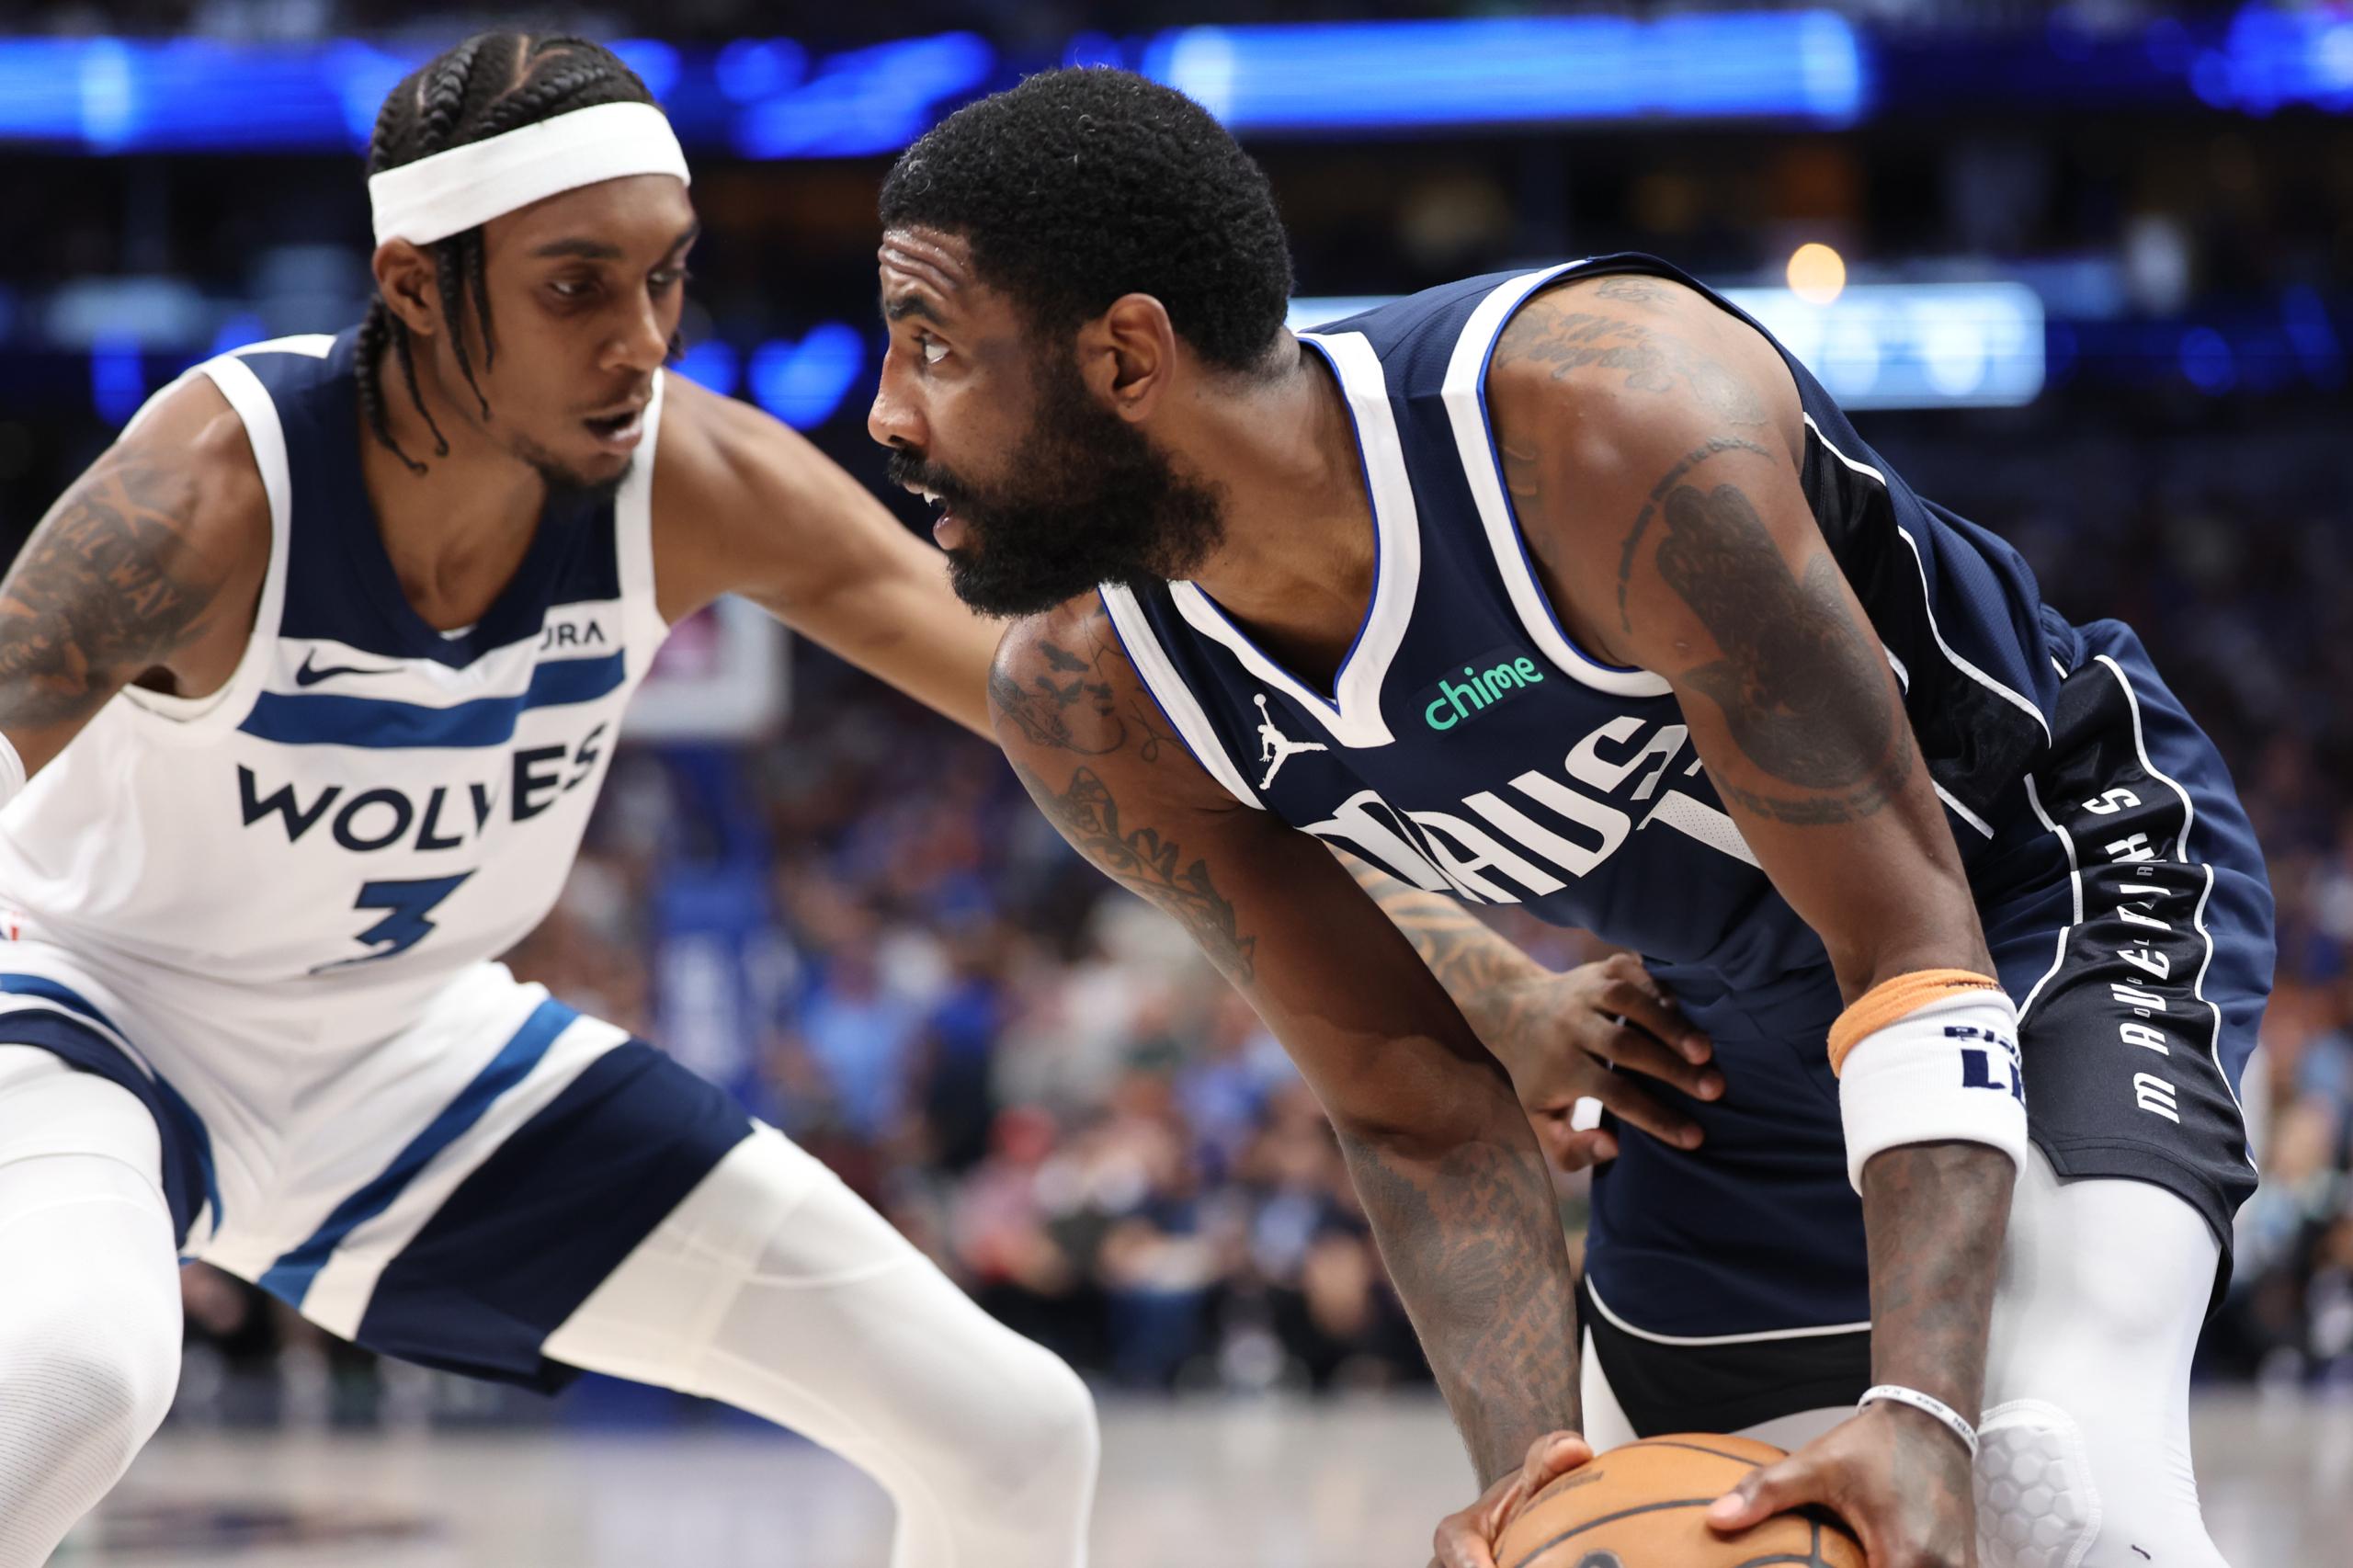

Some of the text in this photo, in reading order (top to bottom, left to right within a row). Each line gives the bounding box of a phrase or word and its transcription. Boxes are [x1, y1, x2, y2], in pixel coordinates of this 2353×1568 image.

[1424, 654, 1544, 731] chime
[236, 722, 609, 853] WOLVES
[308, 868, 481, 976] 3
[2081, 787, 2181, 1125] MAVEIKS
